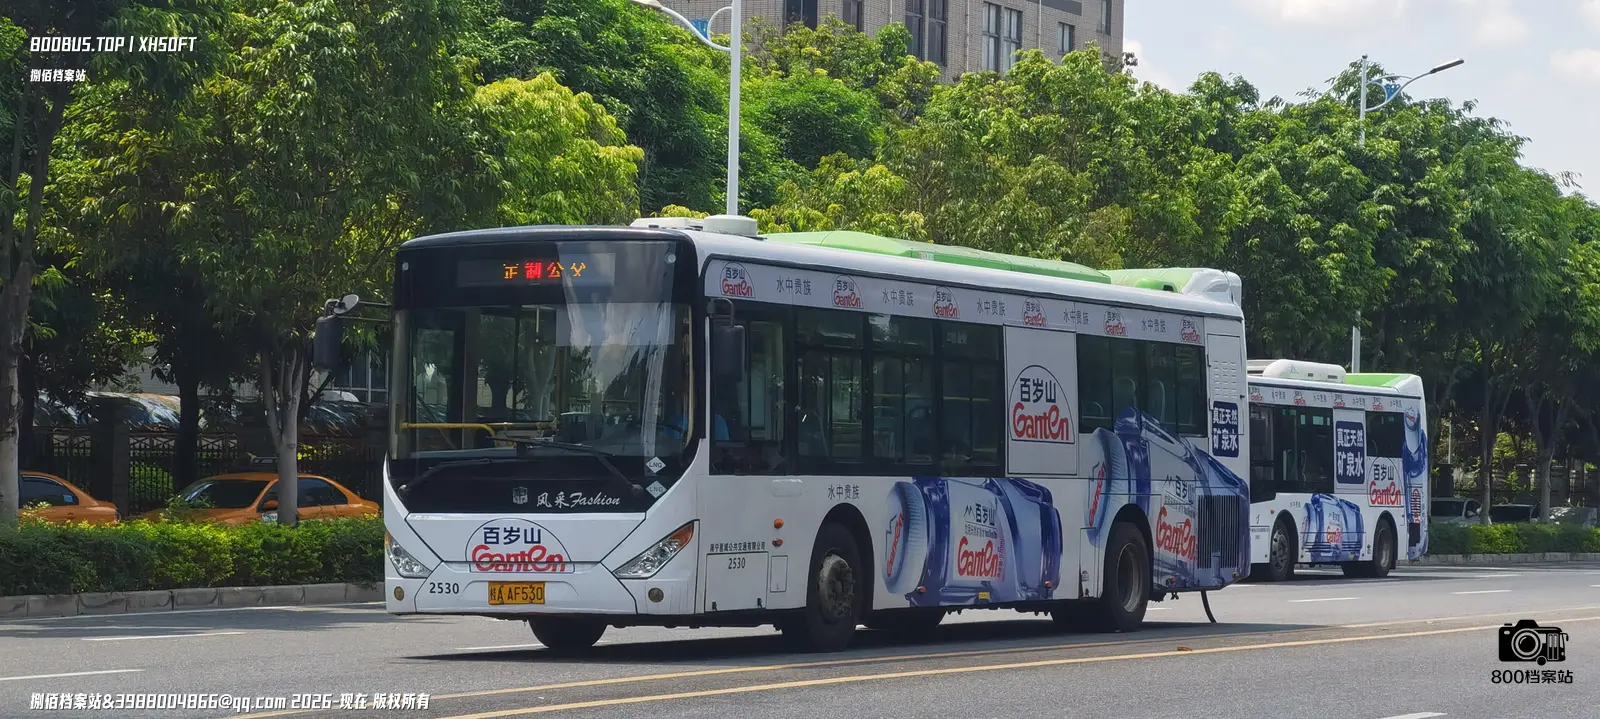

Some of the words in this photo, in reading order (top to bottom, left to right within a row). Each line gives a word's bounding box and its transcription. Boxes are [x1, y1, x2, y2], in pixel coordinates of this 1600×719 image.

[725, 267, 745, 280] 百岁山
[776, 276, 811, 296] 水中贵族
[836, 280, 855, 292] 百岁山
[882, 287, 914, 306] 水中贵族
[976, 297, 1006, 316] 水中贵族
[1020, 378, 1057, 404] 百岁山
[1213, 406, 1238, 425] 真正天然
[1213, 428, 1238, 451] 矿泉水
[1337, 428, 1364, 447] 真正天然
[1337, 451, 1364, 477] 矿泉水
[1373, 463, 1394, 481] 百岁山
[827, 484, 860, 500] 水中贵族
[976, 502, 995, 526] 百岁山
[483, 527, 541, 545] 百岁山
[728, 557, 746, 569] 2530
[429, 582, 460, 595] 2530
